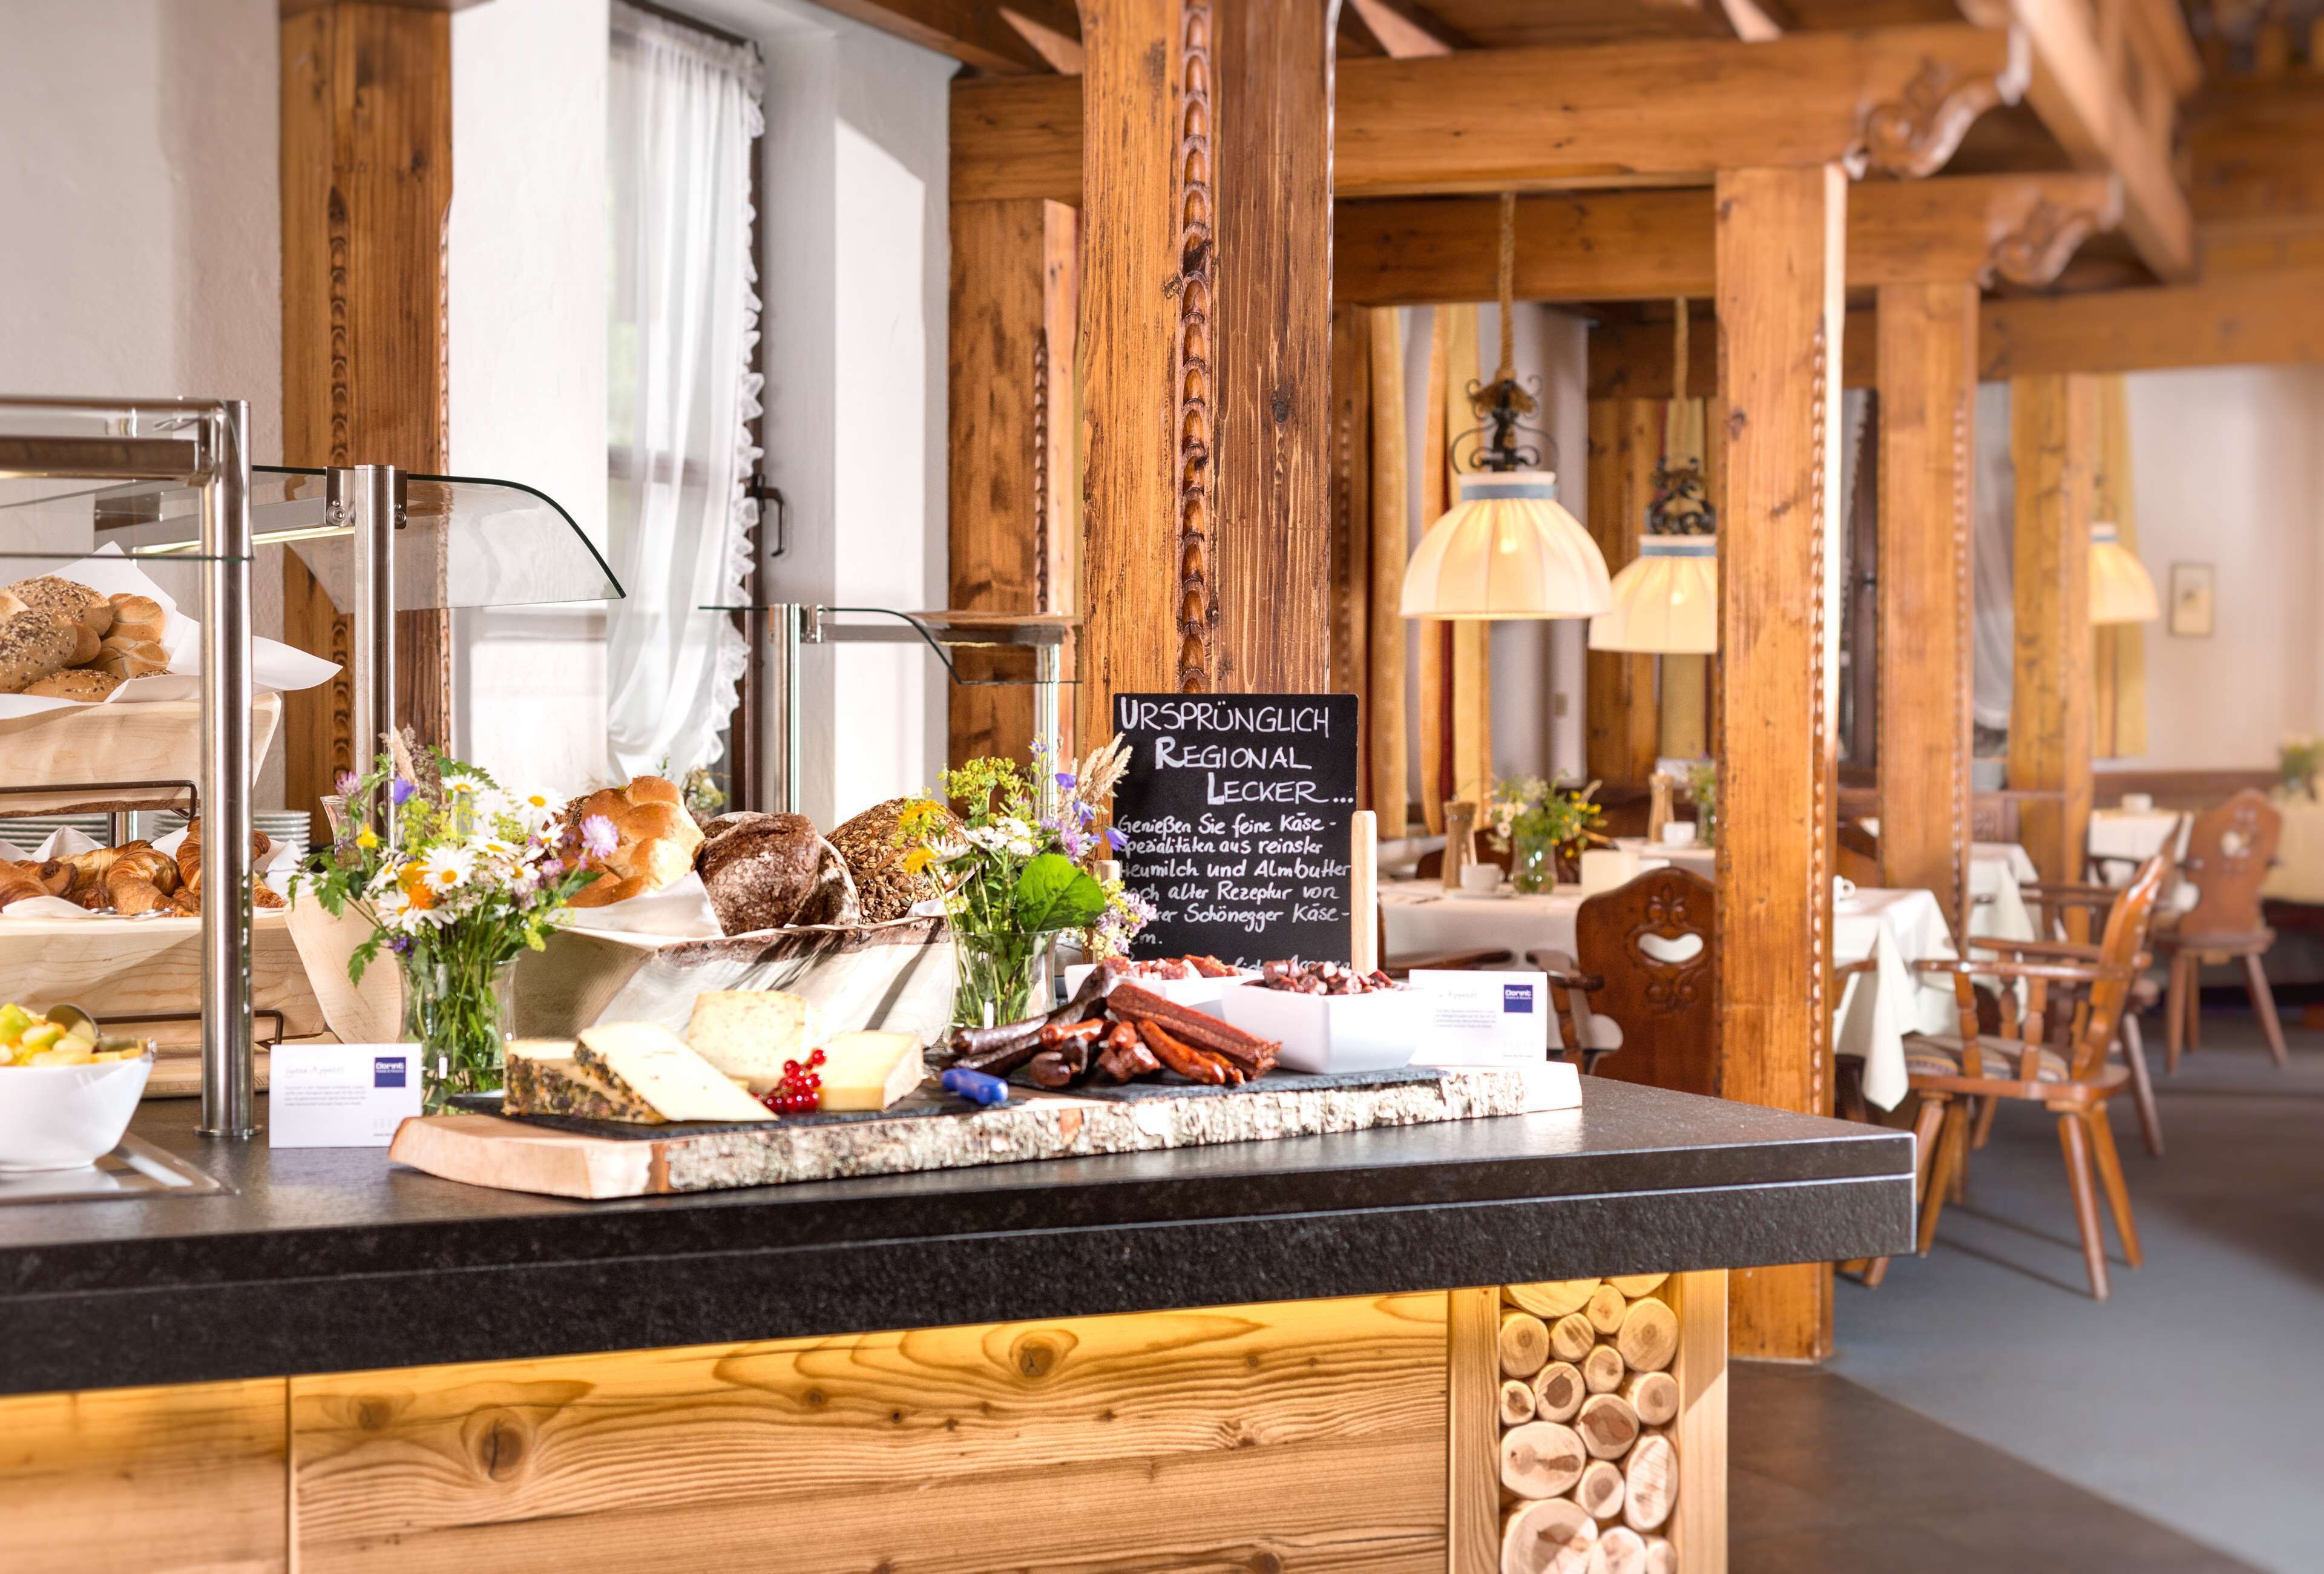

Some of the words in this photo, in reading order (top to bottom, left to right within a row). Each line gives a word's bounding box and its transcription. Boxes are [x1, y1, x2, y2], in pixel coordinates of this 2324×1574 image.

[1120, 696, 1329, 738] URSPRÜNGLICH
[1155, 736, 1312, 769] REGIONAL
[1118, 814, 1191, 841] Genießen
[1198, 812, 1226, 834] Sie
[1232, 812, 1273, 838] feine
[1219, 840, 1252, 854] aus
[1258, 835, 1323, 855] reinster
[1207, 858, 1247, 877] und
[1253, 857, 1351, 879] Almbutter
[1167, 883, 1209, 900] alter
[1217, 880, 1293, 905] Rezeptur
[1302, 886, 1341, 899] von
[1184, 902, 1284, 933] Schönegger
